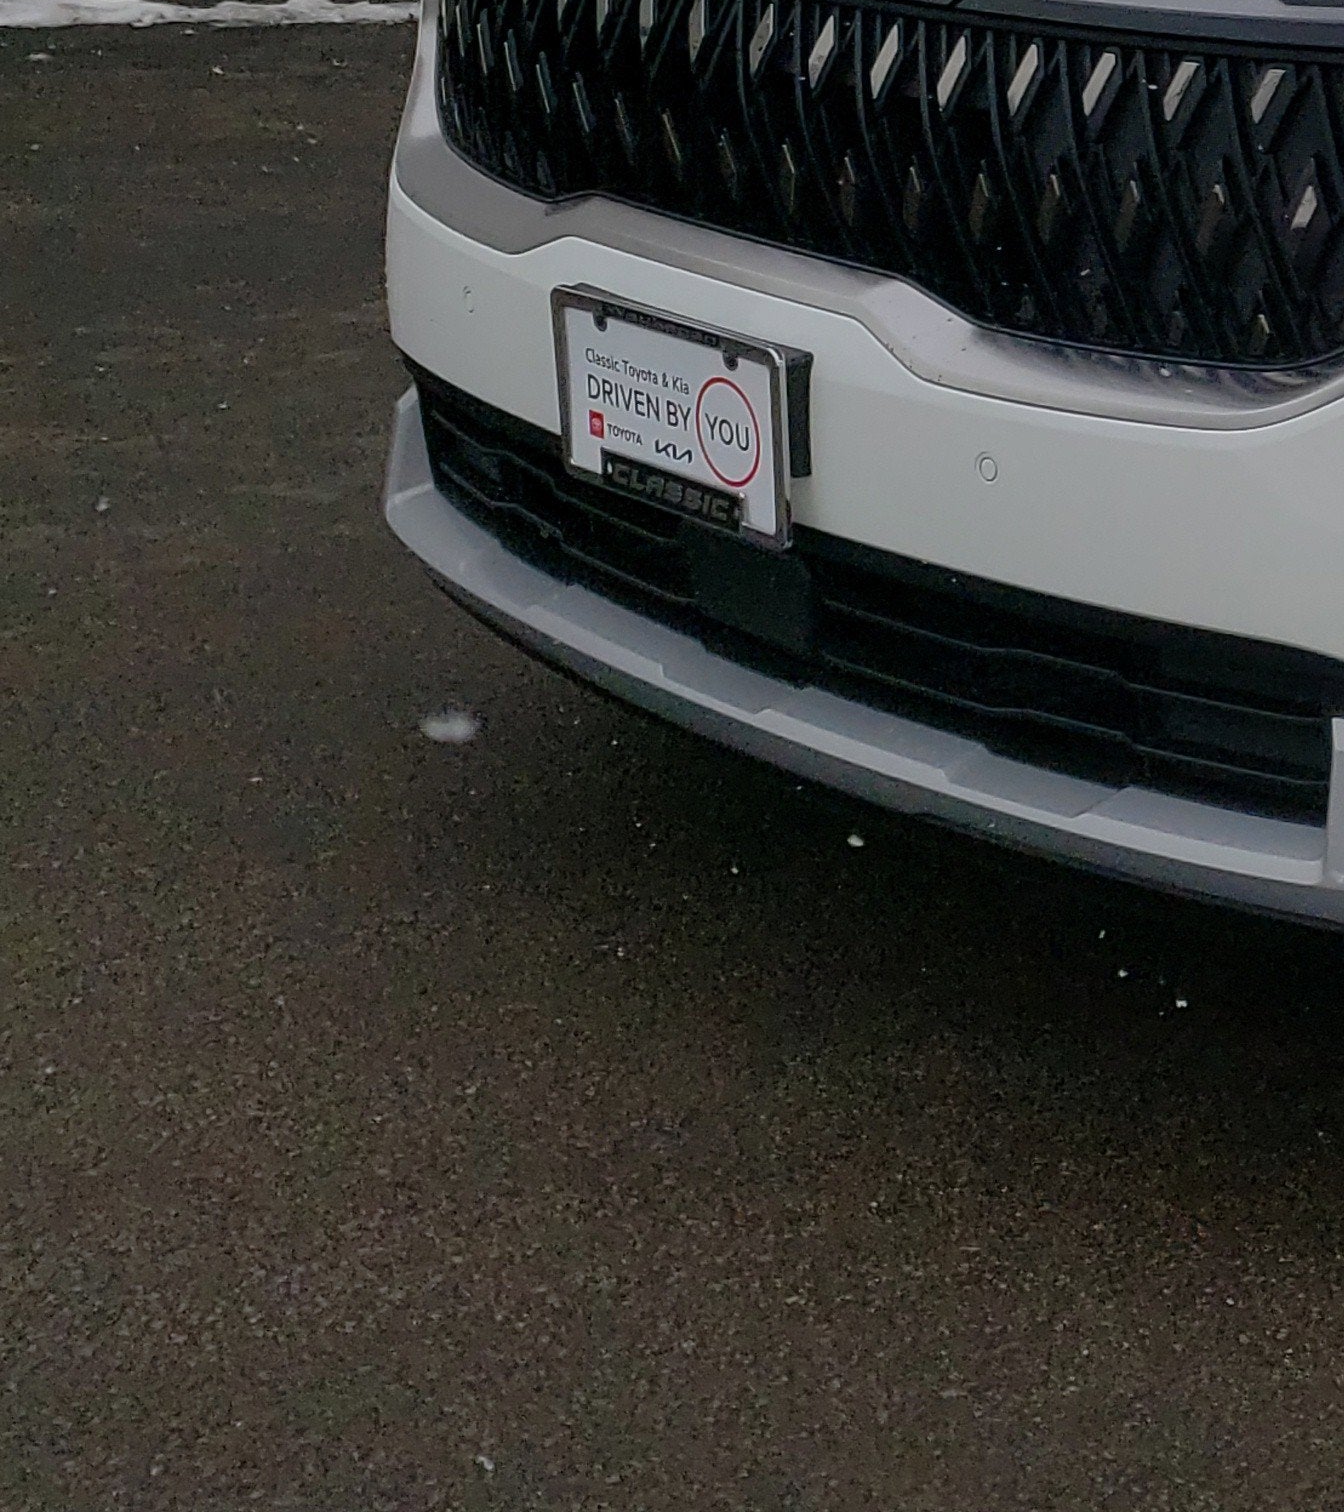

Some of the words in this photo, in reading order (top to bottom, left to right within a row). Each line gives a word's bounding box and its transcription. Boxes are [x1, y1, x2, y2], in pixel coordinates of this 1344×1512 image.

[585, 347, 620, 373] Classic
[621, 359, 659, 386] Toyota
[661, 372, 669, 388] &
[672, 375, 690, 395] Kia
[587, 373, 661, 422] DRIVEN
[666, 399, 692, 432] BY
[704, 413, 751, 452] YOU
[607, 422, 644, 446] TOYOTA
[654, 438, 694, 464] KIA
[612, 461, 730, 522] CLASSIC
